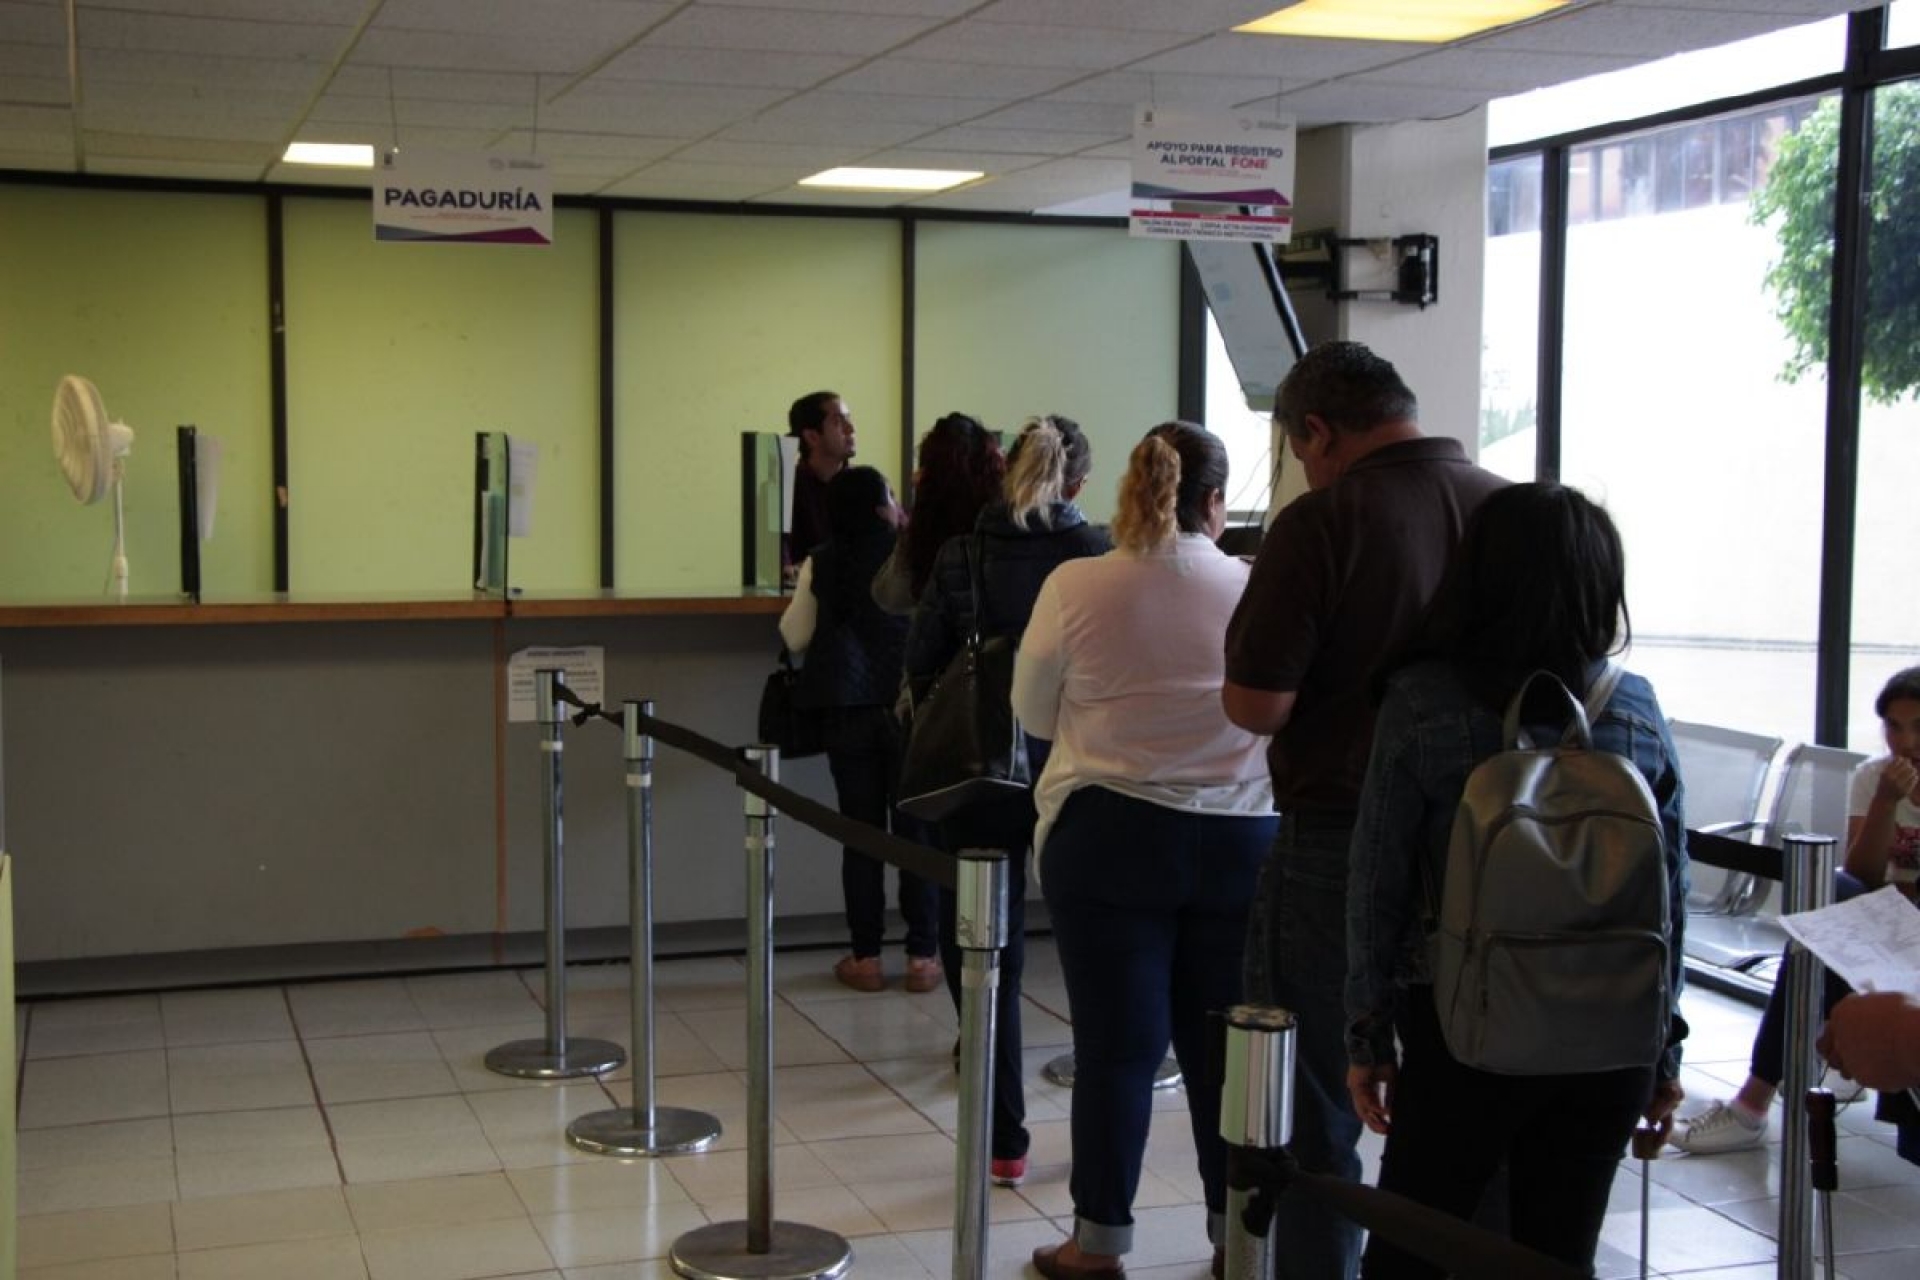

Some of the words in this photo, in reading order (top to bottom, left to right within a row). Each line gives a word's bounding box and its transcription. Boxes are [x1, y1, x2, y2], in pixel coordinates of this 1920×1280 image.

[1147, 141, 1188, 152] APOYO
[1191, 143, 1223, 154] PARA
[1225, 145, 1283, 158] REGISTRO
[1160, 154, 1177, 165] AL
[1179, 155, 1226, 167] PORTAL
[1231, 158, 1268, 170] FONE
[385, 187, 541, 211] PAGADURÍA
